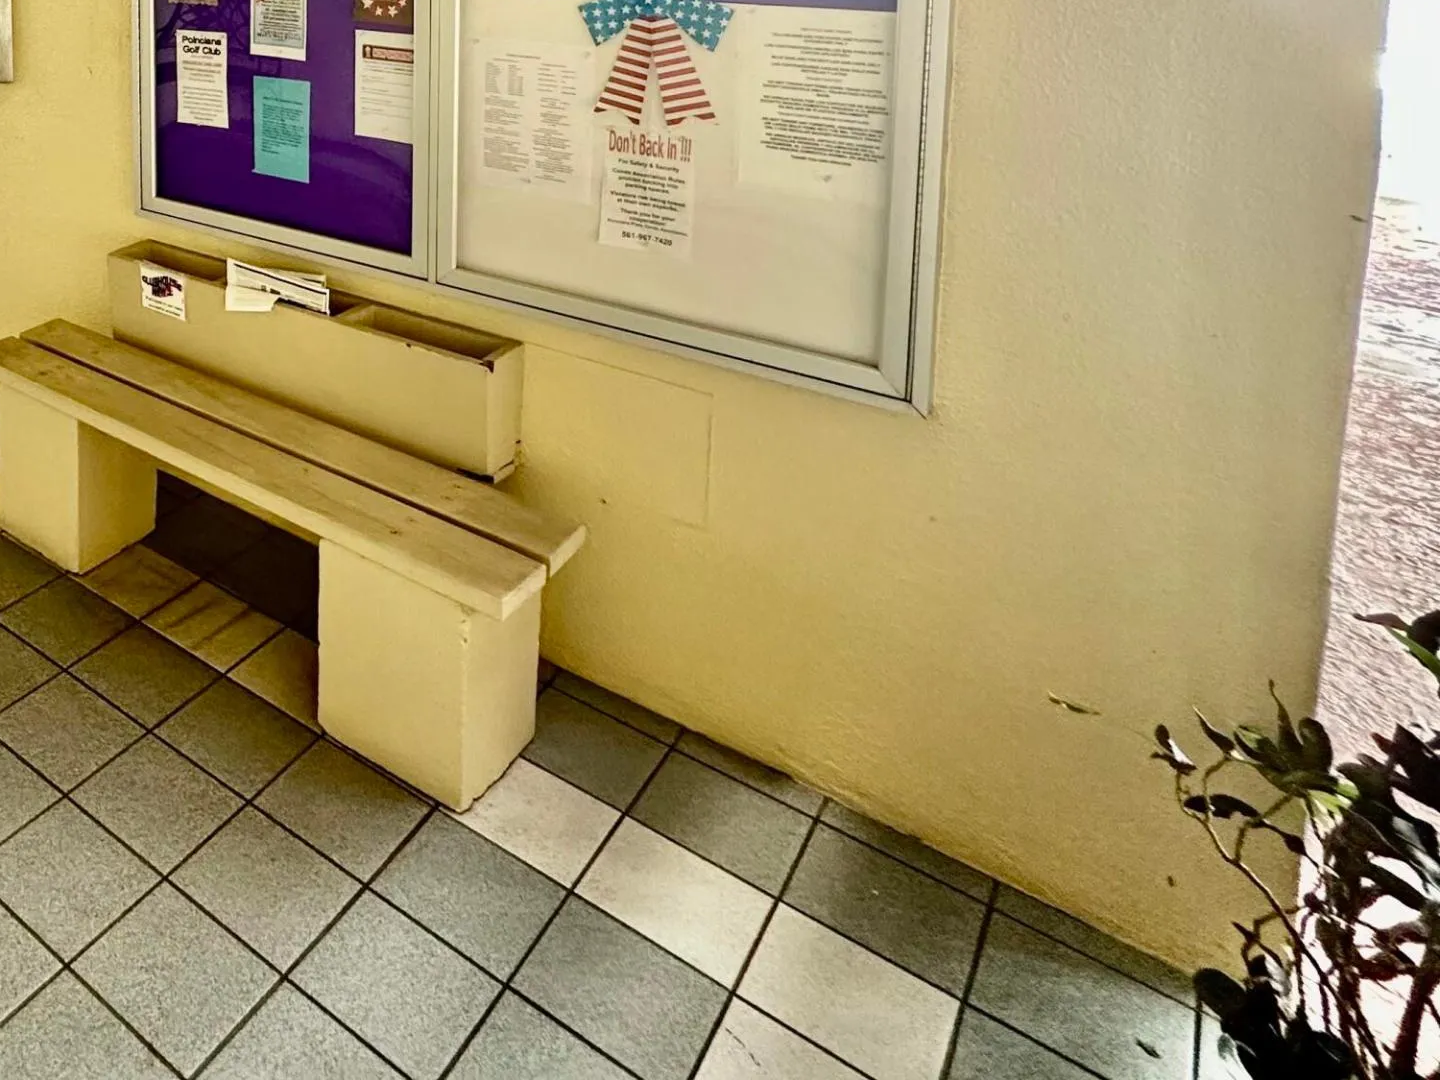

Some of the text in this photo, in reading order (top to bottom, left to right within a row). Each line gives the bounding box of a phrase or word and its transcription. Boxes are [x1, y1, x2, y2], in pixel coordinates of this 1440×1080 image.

[182, 35, 221, 46] Poinciana
[183, 45, 221, 56] Golf Club
[609, 130, 636, 155] Don't
[639, 133, 664, 159] Back
[667, 137, 677, 160] In
[630, 160, 647, 168] Safety
